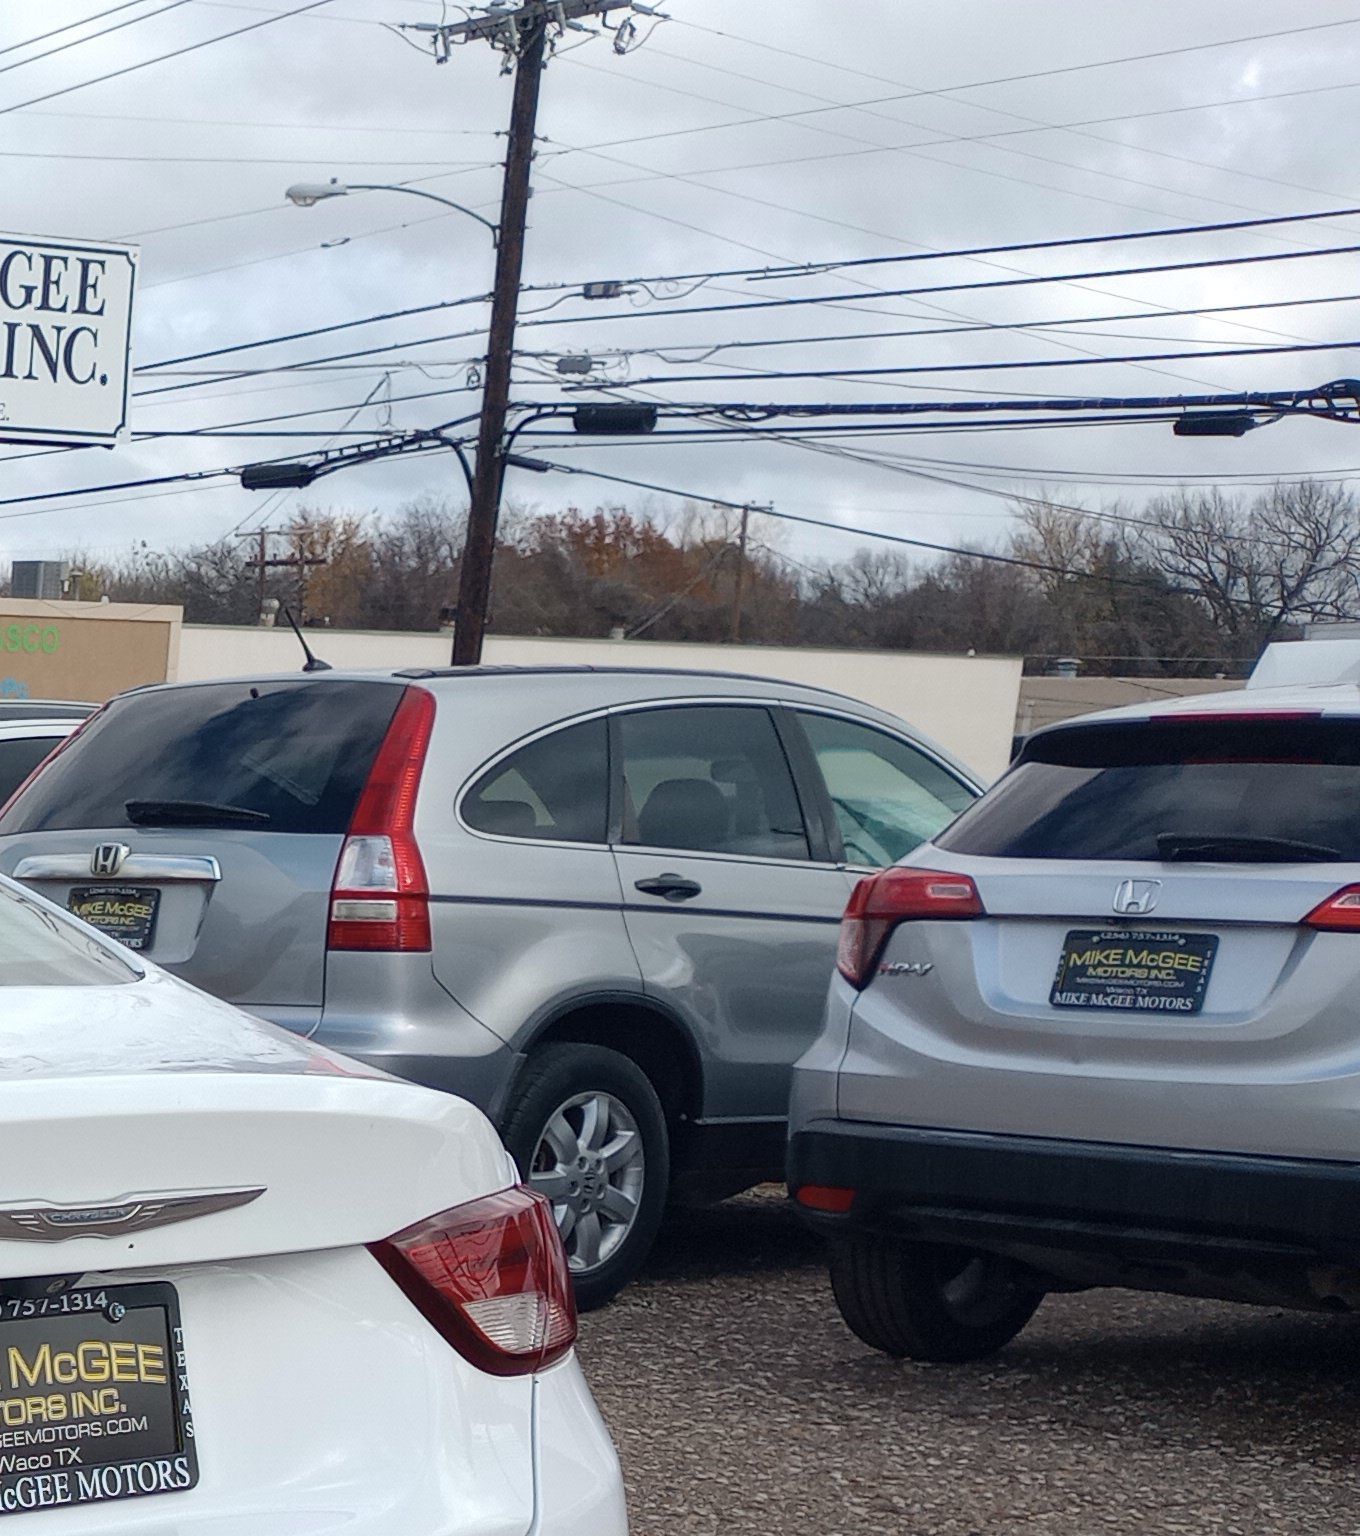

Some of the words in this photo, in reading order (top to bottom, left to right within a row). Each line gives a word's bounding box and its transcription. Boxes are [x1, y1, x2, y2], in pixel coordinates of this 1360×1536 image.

[1069, 949, 1121, 968] MIKE
[1125, 950, 1203, 972] McGEE
[1086, 967, 1149, 977] MOTORS
[1053, 992, 1089, 1005] MIKE
[1089, 993, 1135, 1007] McGEE
[1137, 996, 1194, 1010] MOTORS
[9, 1291, 108, 1317] 757-1314
[8, 1341, 167, 1389] McGEE
[71, 1388, 127, 1419] INC.
[53, 1446, 82, 1465] TX
[78, 1457, 191, 1501] MOTORS
